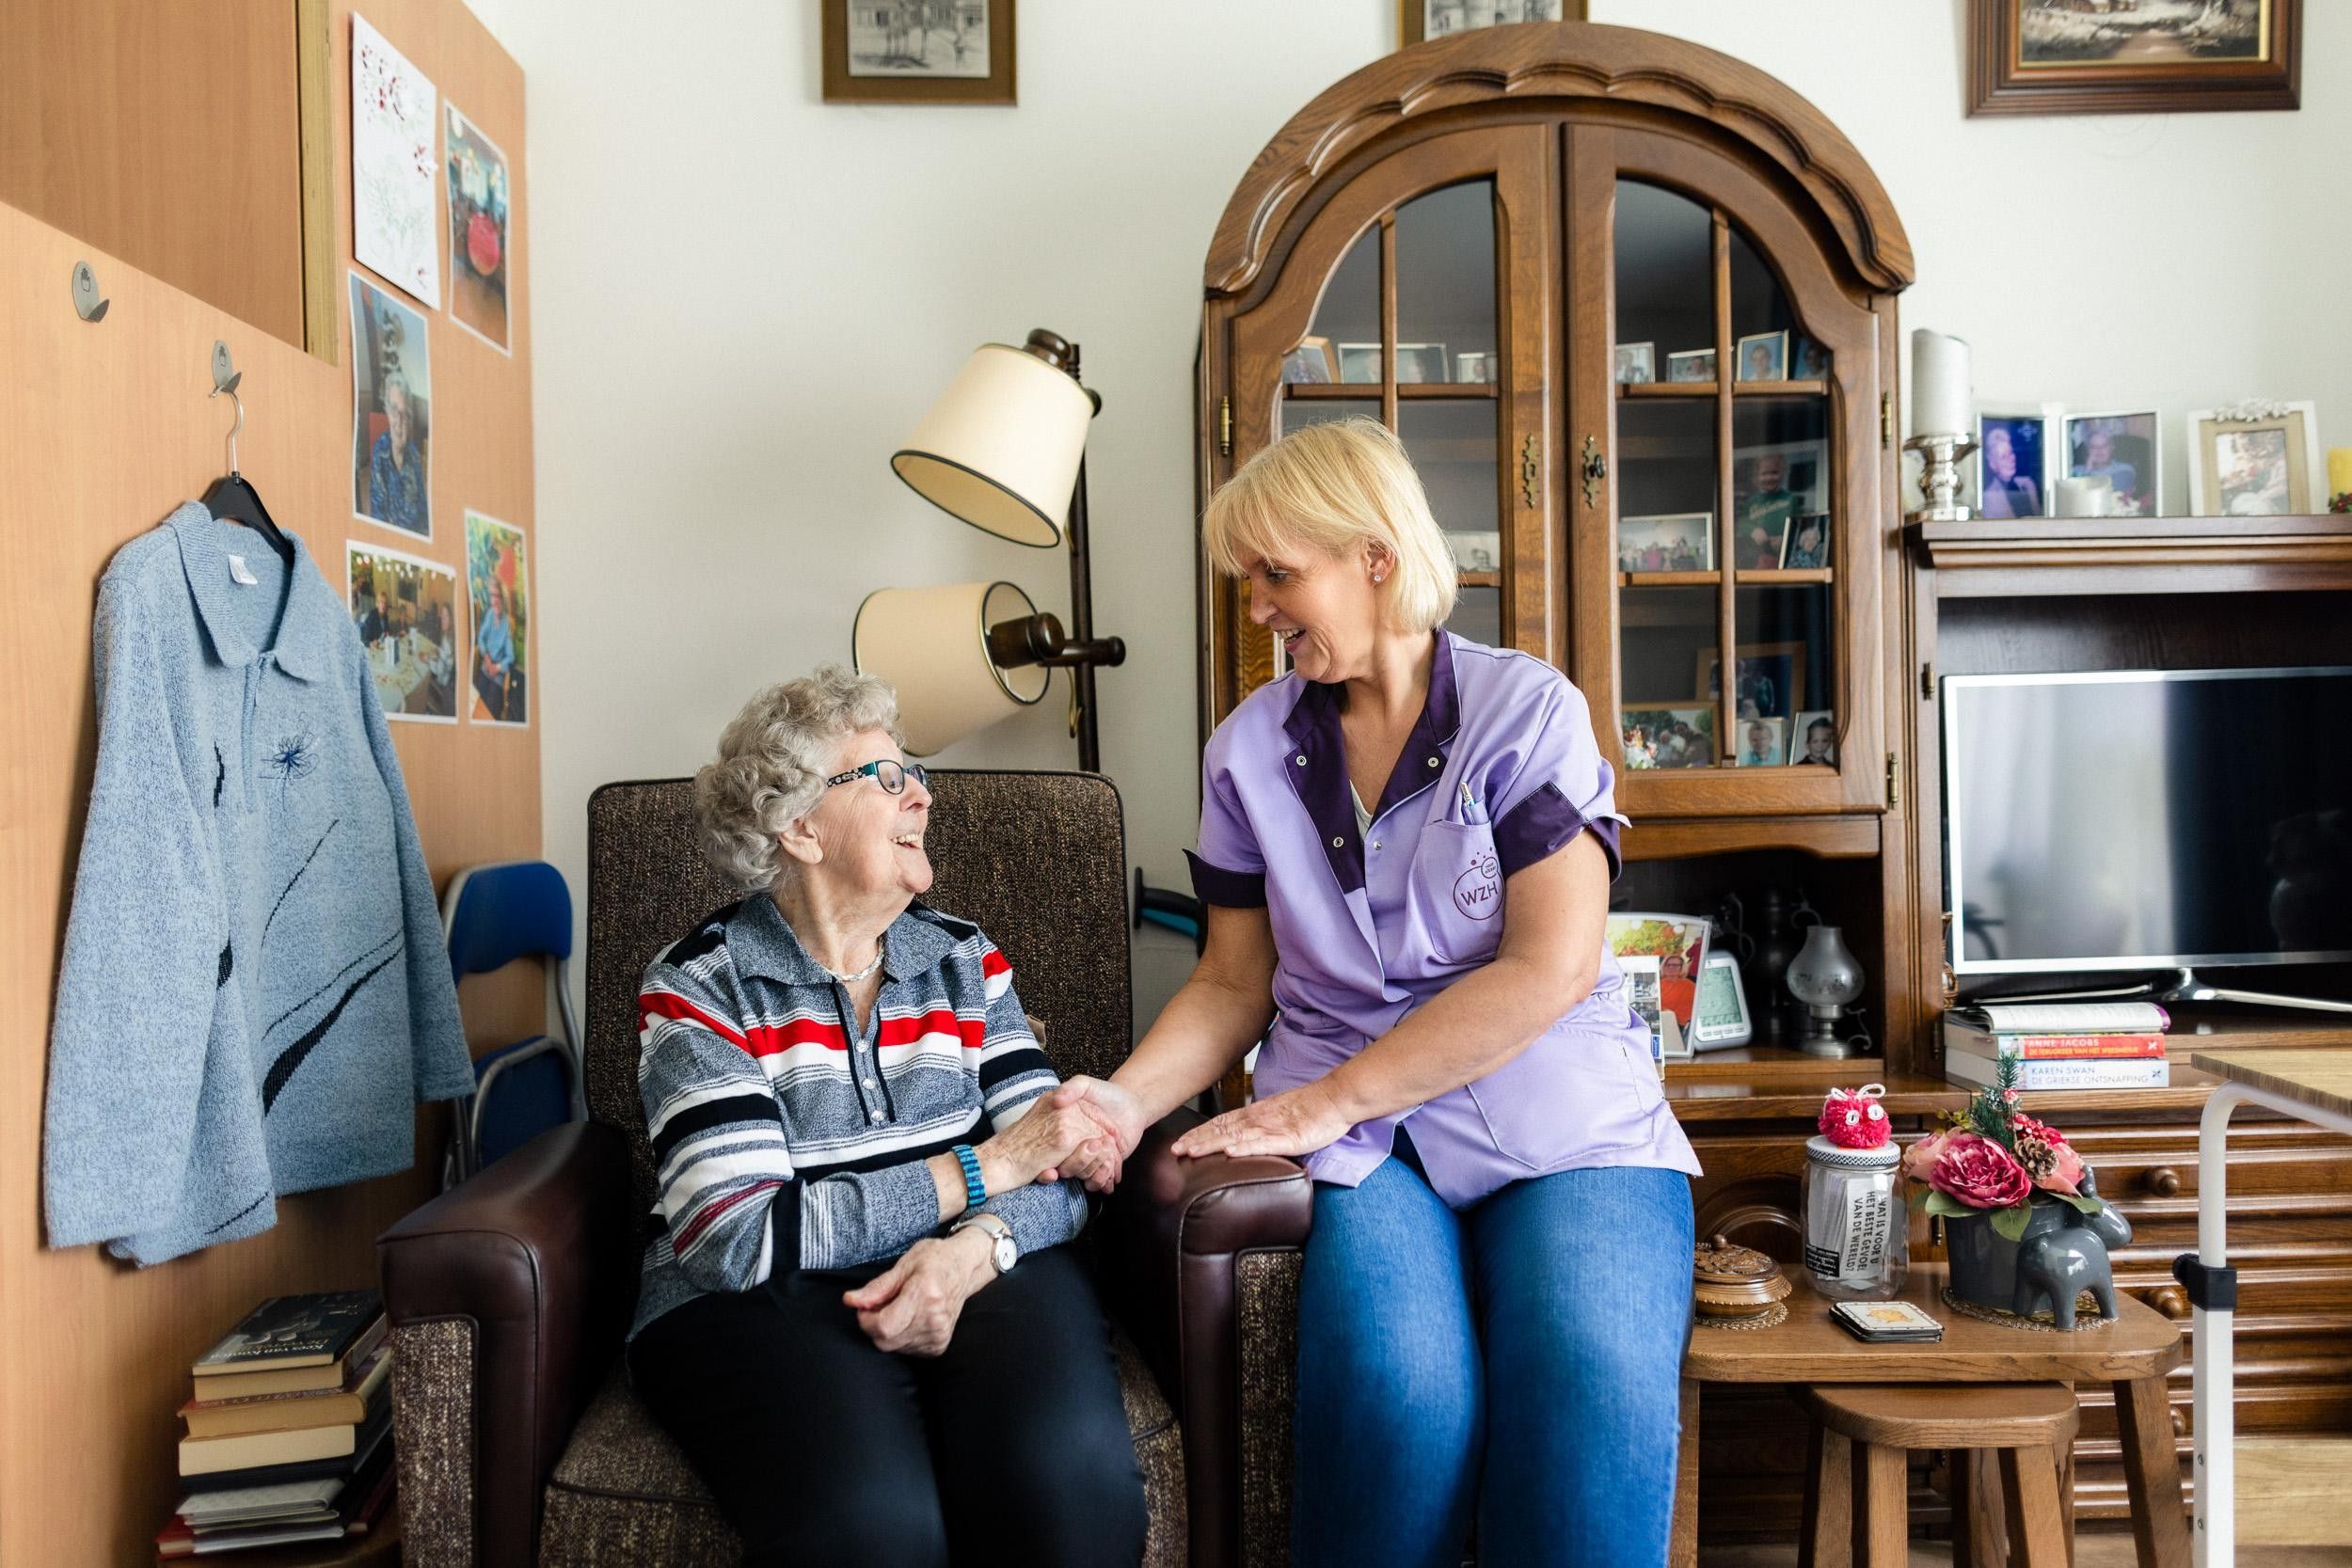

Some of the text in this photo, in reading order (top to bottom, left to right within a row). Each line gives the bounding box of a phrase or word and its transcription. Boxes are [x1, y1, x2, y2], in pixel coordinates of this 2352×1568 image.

[1460, 881, 1498, 906] WZH
[2028, 1037, 2099, 1048] ANNE JACOBS
[2031, 1067, 2062, 1075] KAREN
[2031, 1076, 2043, 1085] DE
[2084, 1075, 2149, 1084] ONTSNAPPING
[1845, 1197, 1862, 1272] VAN DE WERELD?
[1857, 1191, 1875, 1272] HET BESTE GEVOEL
[1871, 1230, 1883, 1256] VOOR
